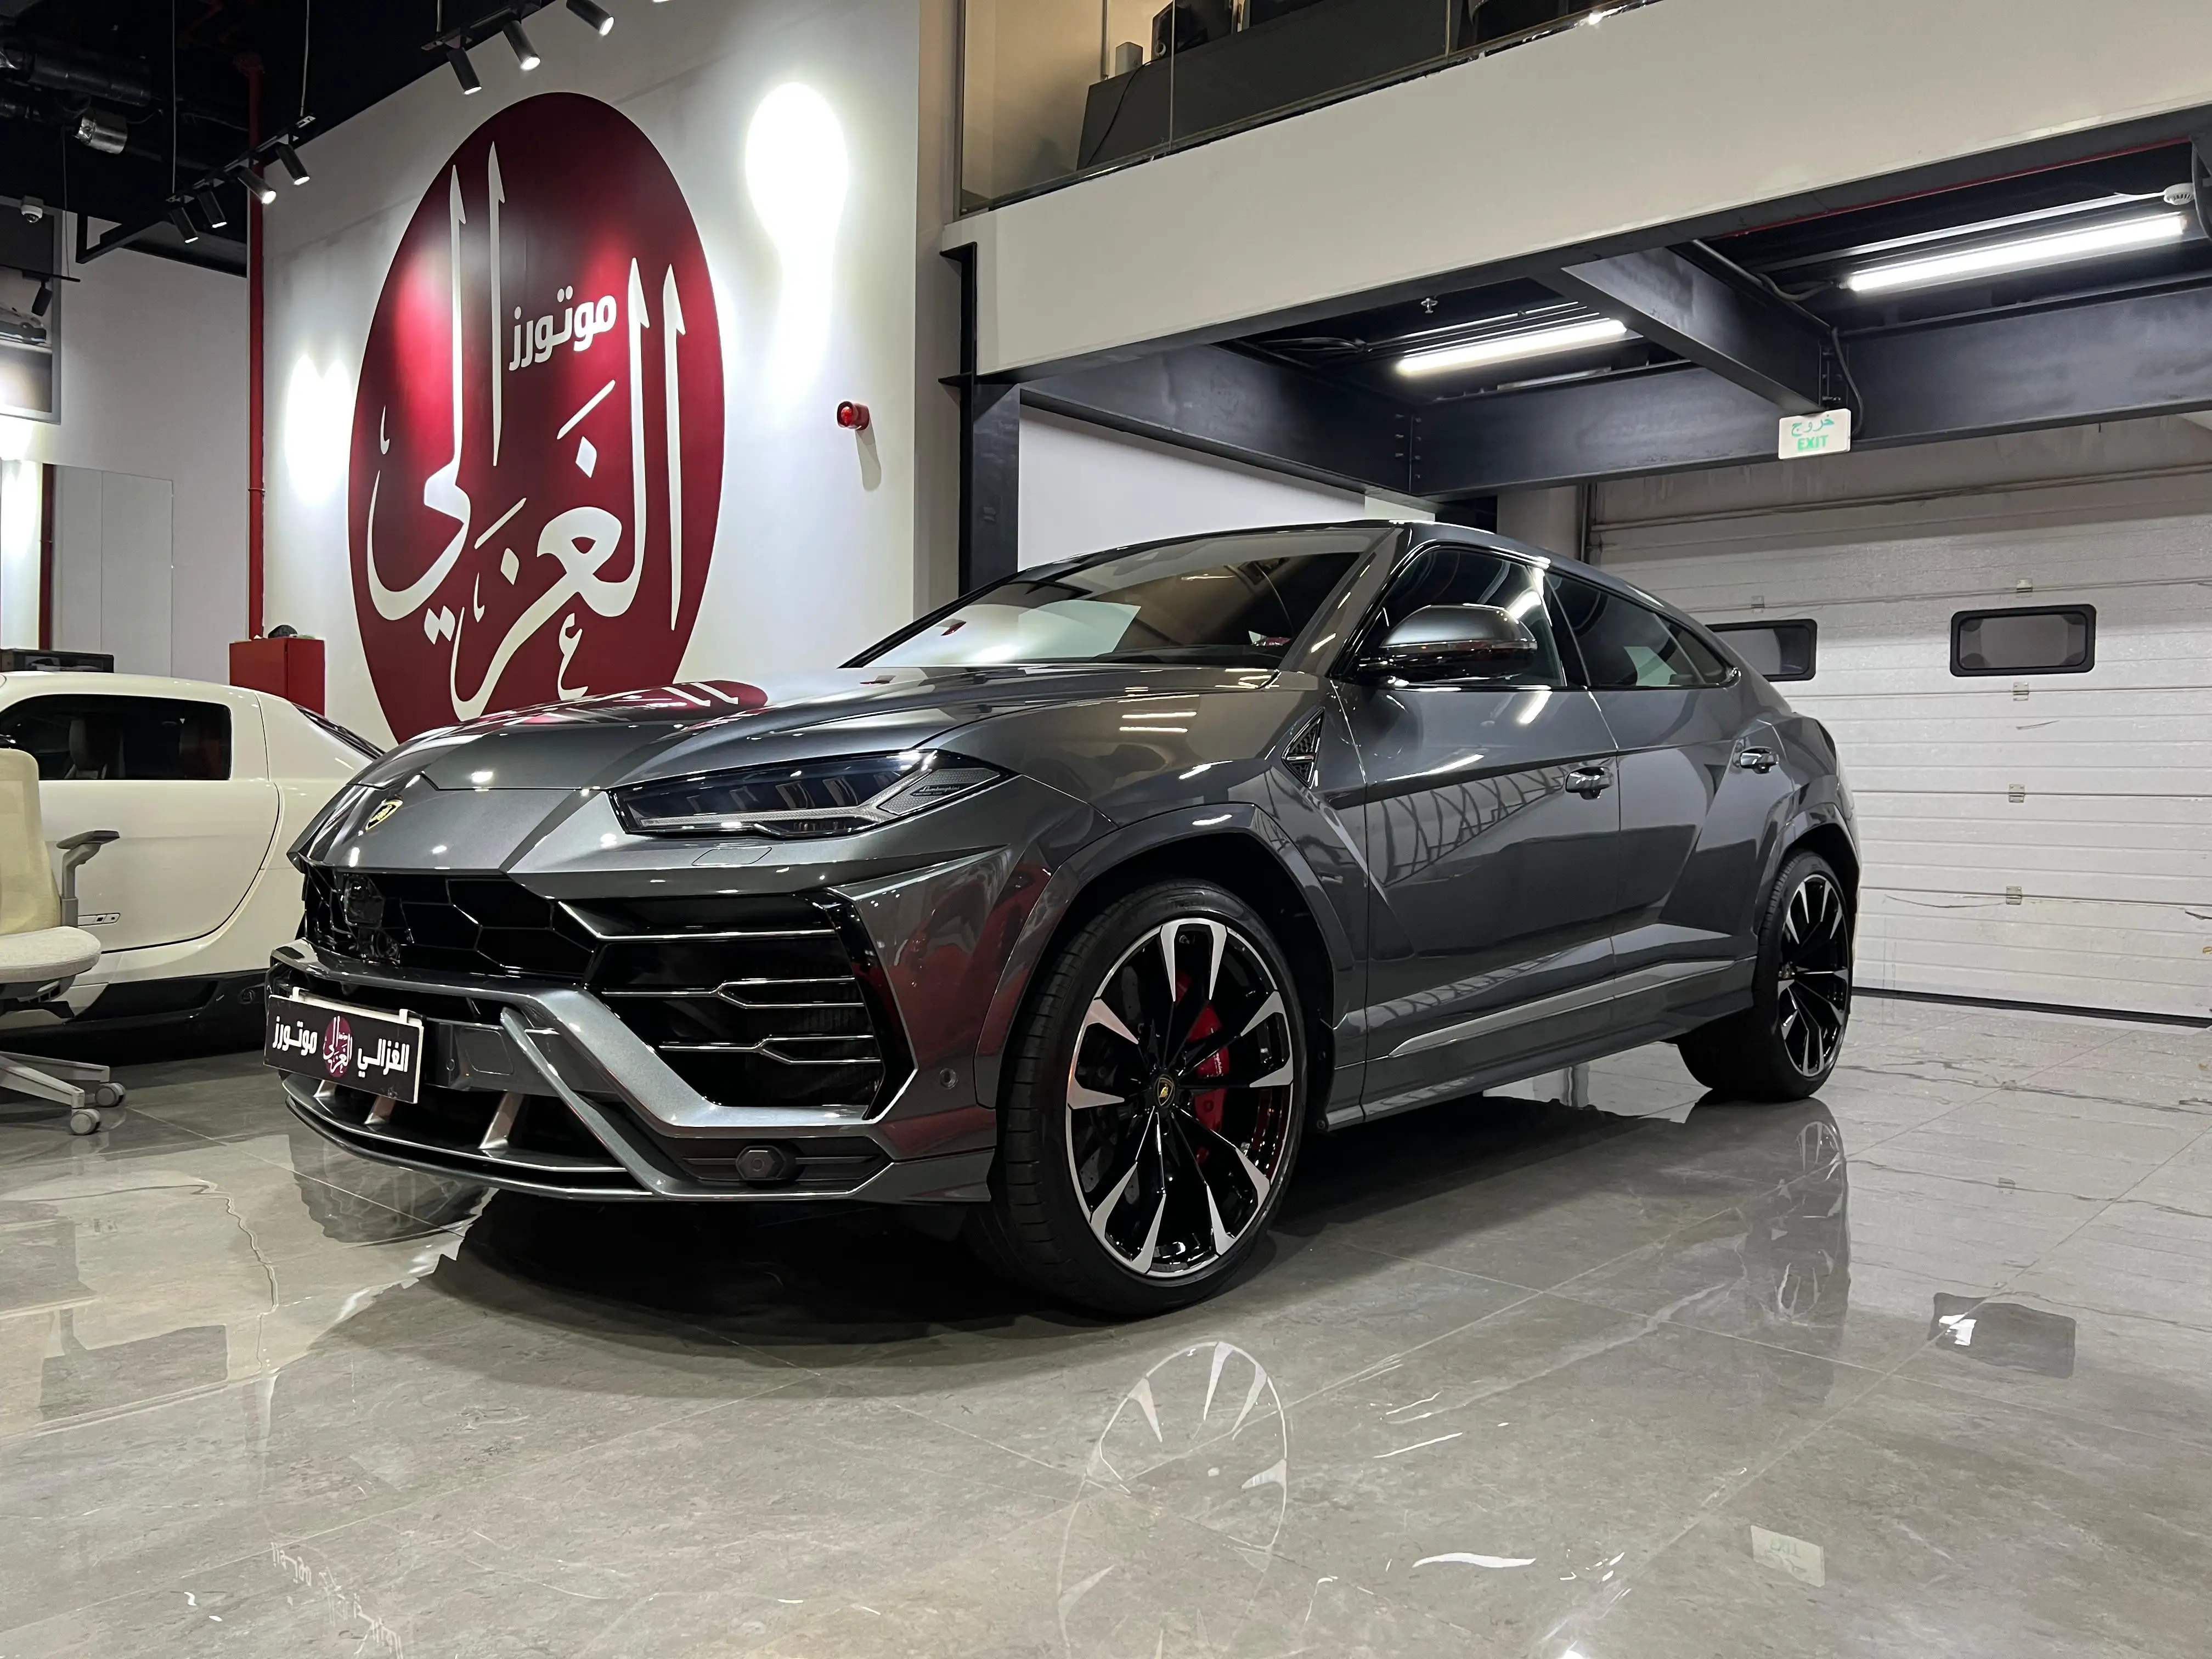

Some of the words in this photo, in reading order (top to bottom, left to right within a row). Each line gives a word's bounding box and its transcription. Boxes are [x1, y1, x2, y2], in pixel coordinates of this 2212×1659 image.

[509, 285, 617, 371] موتورز
[1791, 414, 1835, 437] خروج
[1797, 435, 1829, 450] EXIT
[272, 1015, 318, 1056] موتورز
[357, 1038, 410, 1078] الغزالي
